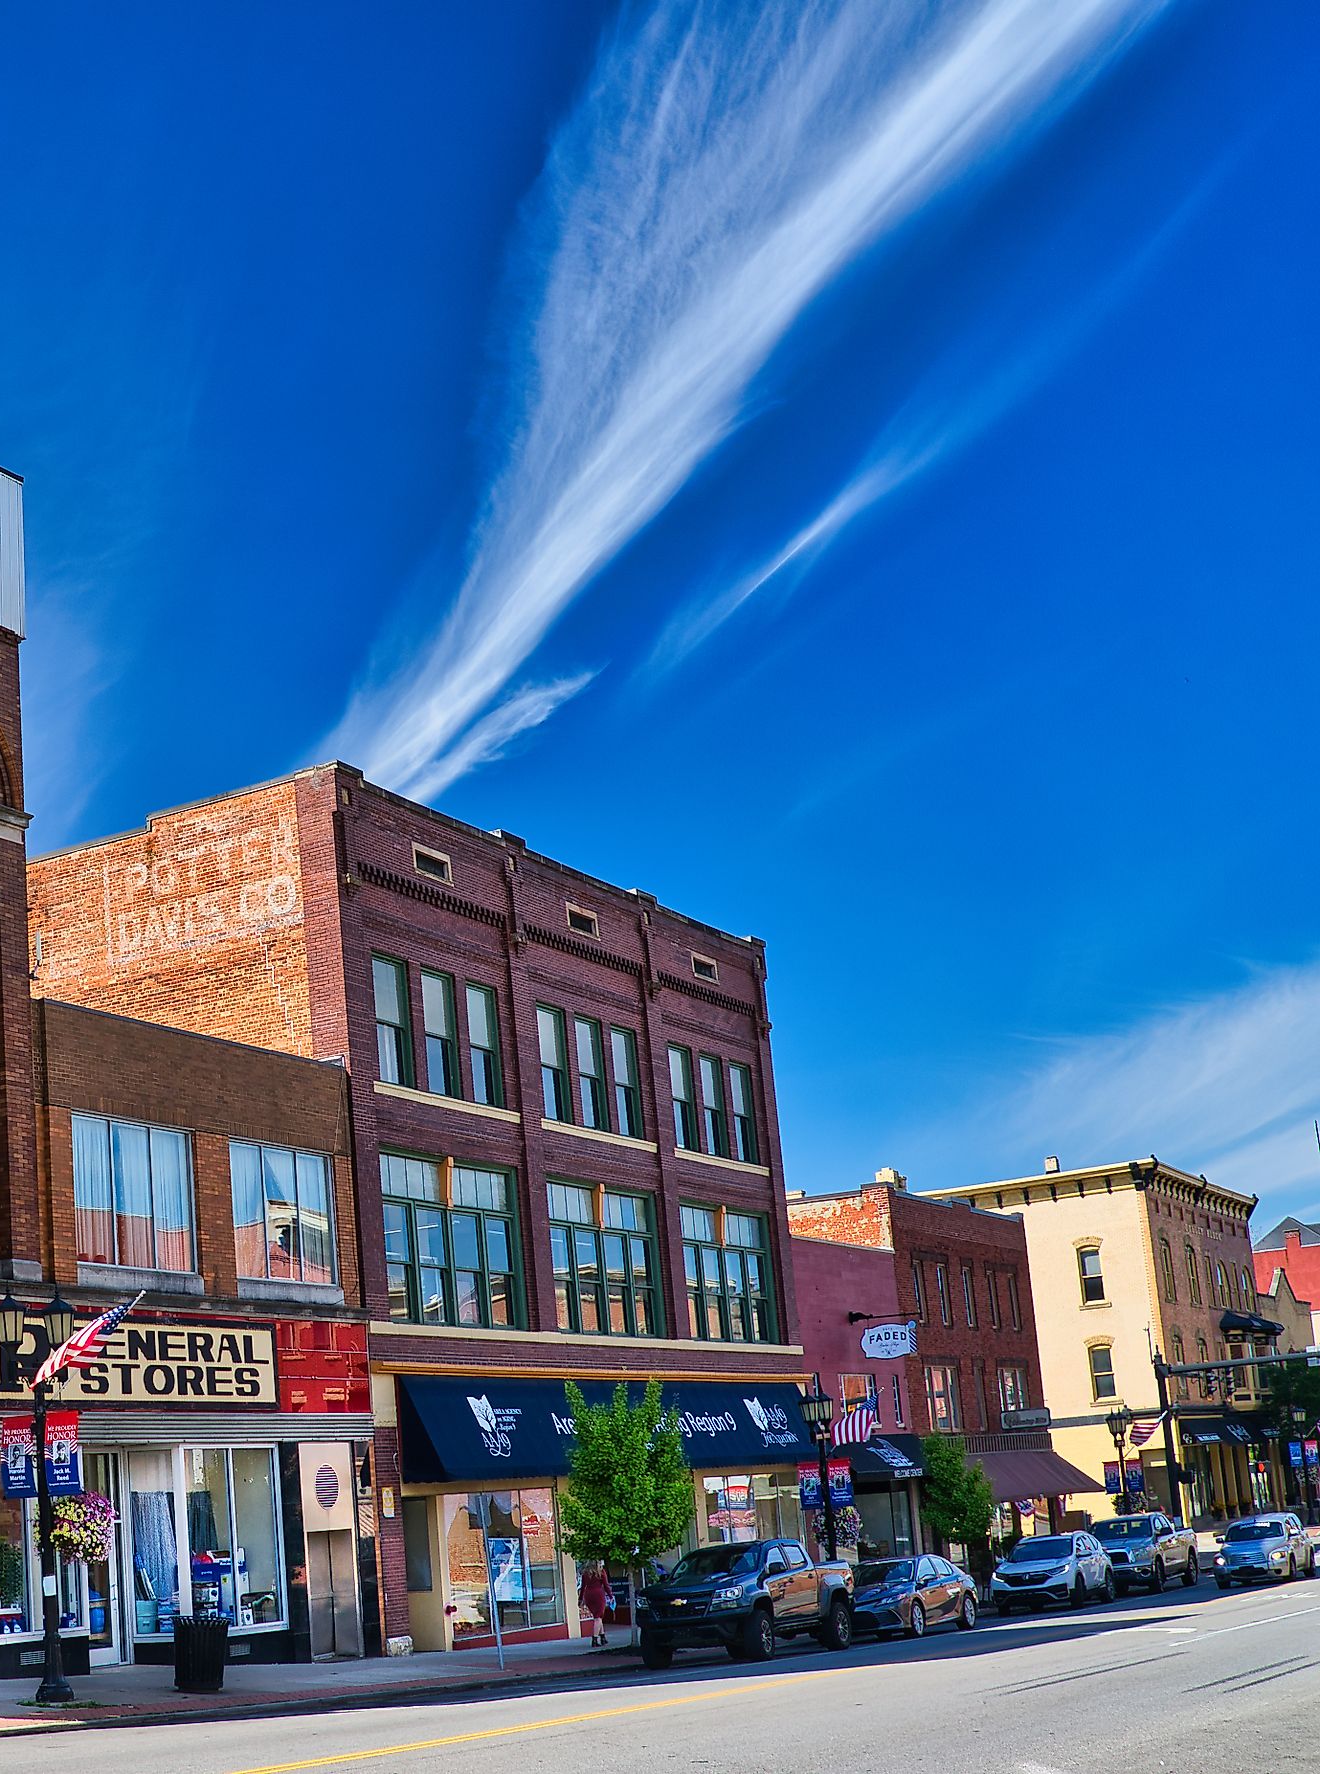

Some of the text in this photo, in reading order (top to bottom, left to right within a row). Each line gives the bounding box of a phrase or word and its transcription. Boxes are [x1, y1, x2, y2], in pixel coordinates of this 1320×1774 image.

[74, 1327, 270, 1365] ENERAL
[869, 1331, 907, 1345] FADED
[80, 1362, 261, 1397] STORES
[551, 1412, 578, 1435] Are
[684, 1411, 725, 1438] Region
[724, 1411, 737, 1431] 9
[3, 1435, 31, 1444] HONOR
[47, 1431, 76, 1440] HONOR
